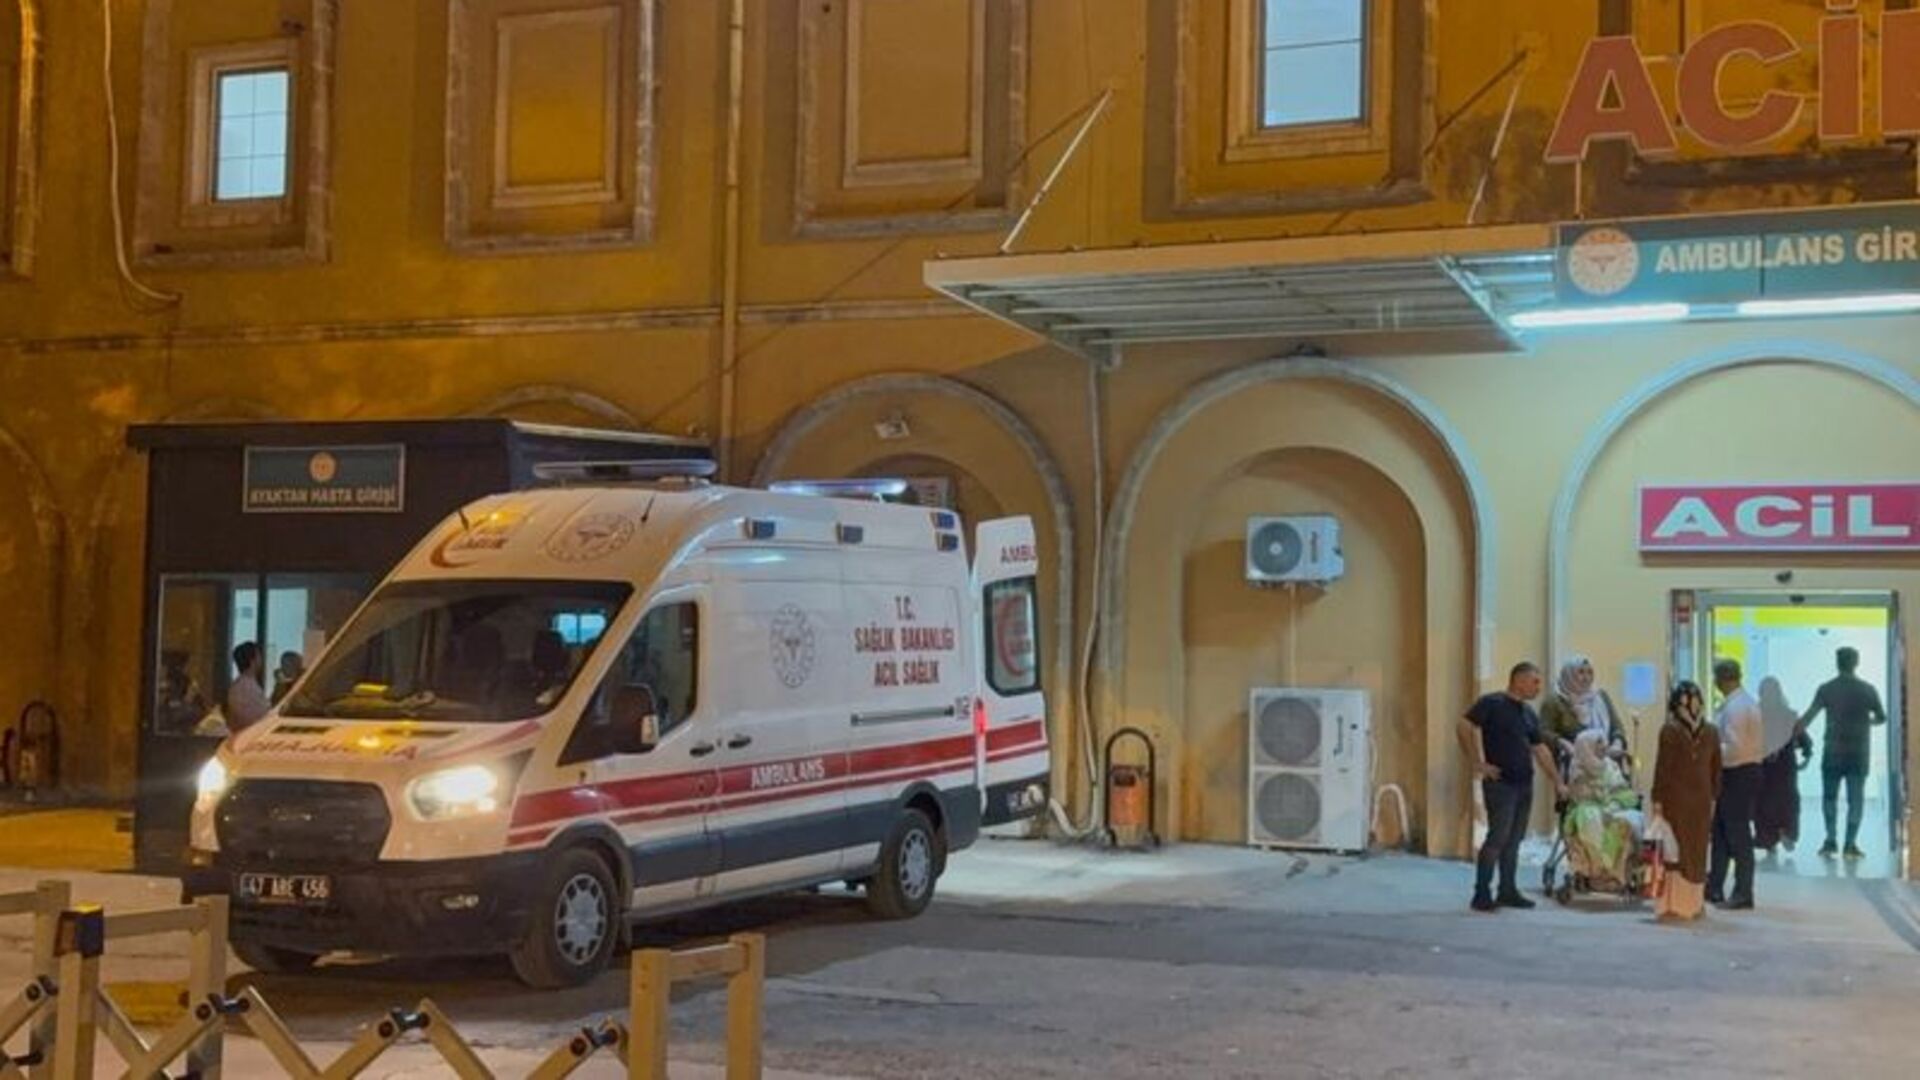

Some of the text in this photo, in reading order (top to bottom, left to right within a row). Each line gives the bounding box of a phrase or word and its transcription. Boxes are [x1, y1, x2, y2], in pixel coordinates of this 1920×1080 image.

[1655, 234, 1845, 273] AMBULANS
[855, 621, 955, 653] SAĞLIK BAKANLIĞI
[903, 655, 940, 685] SAĞLIK
[751, 757, 825, 790] AMBULANS
